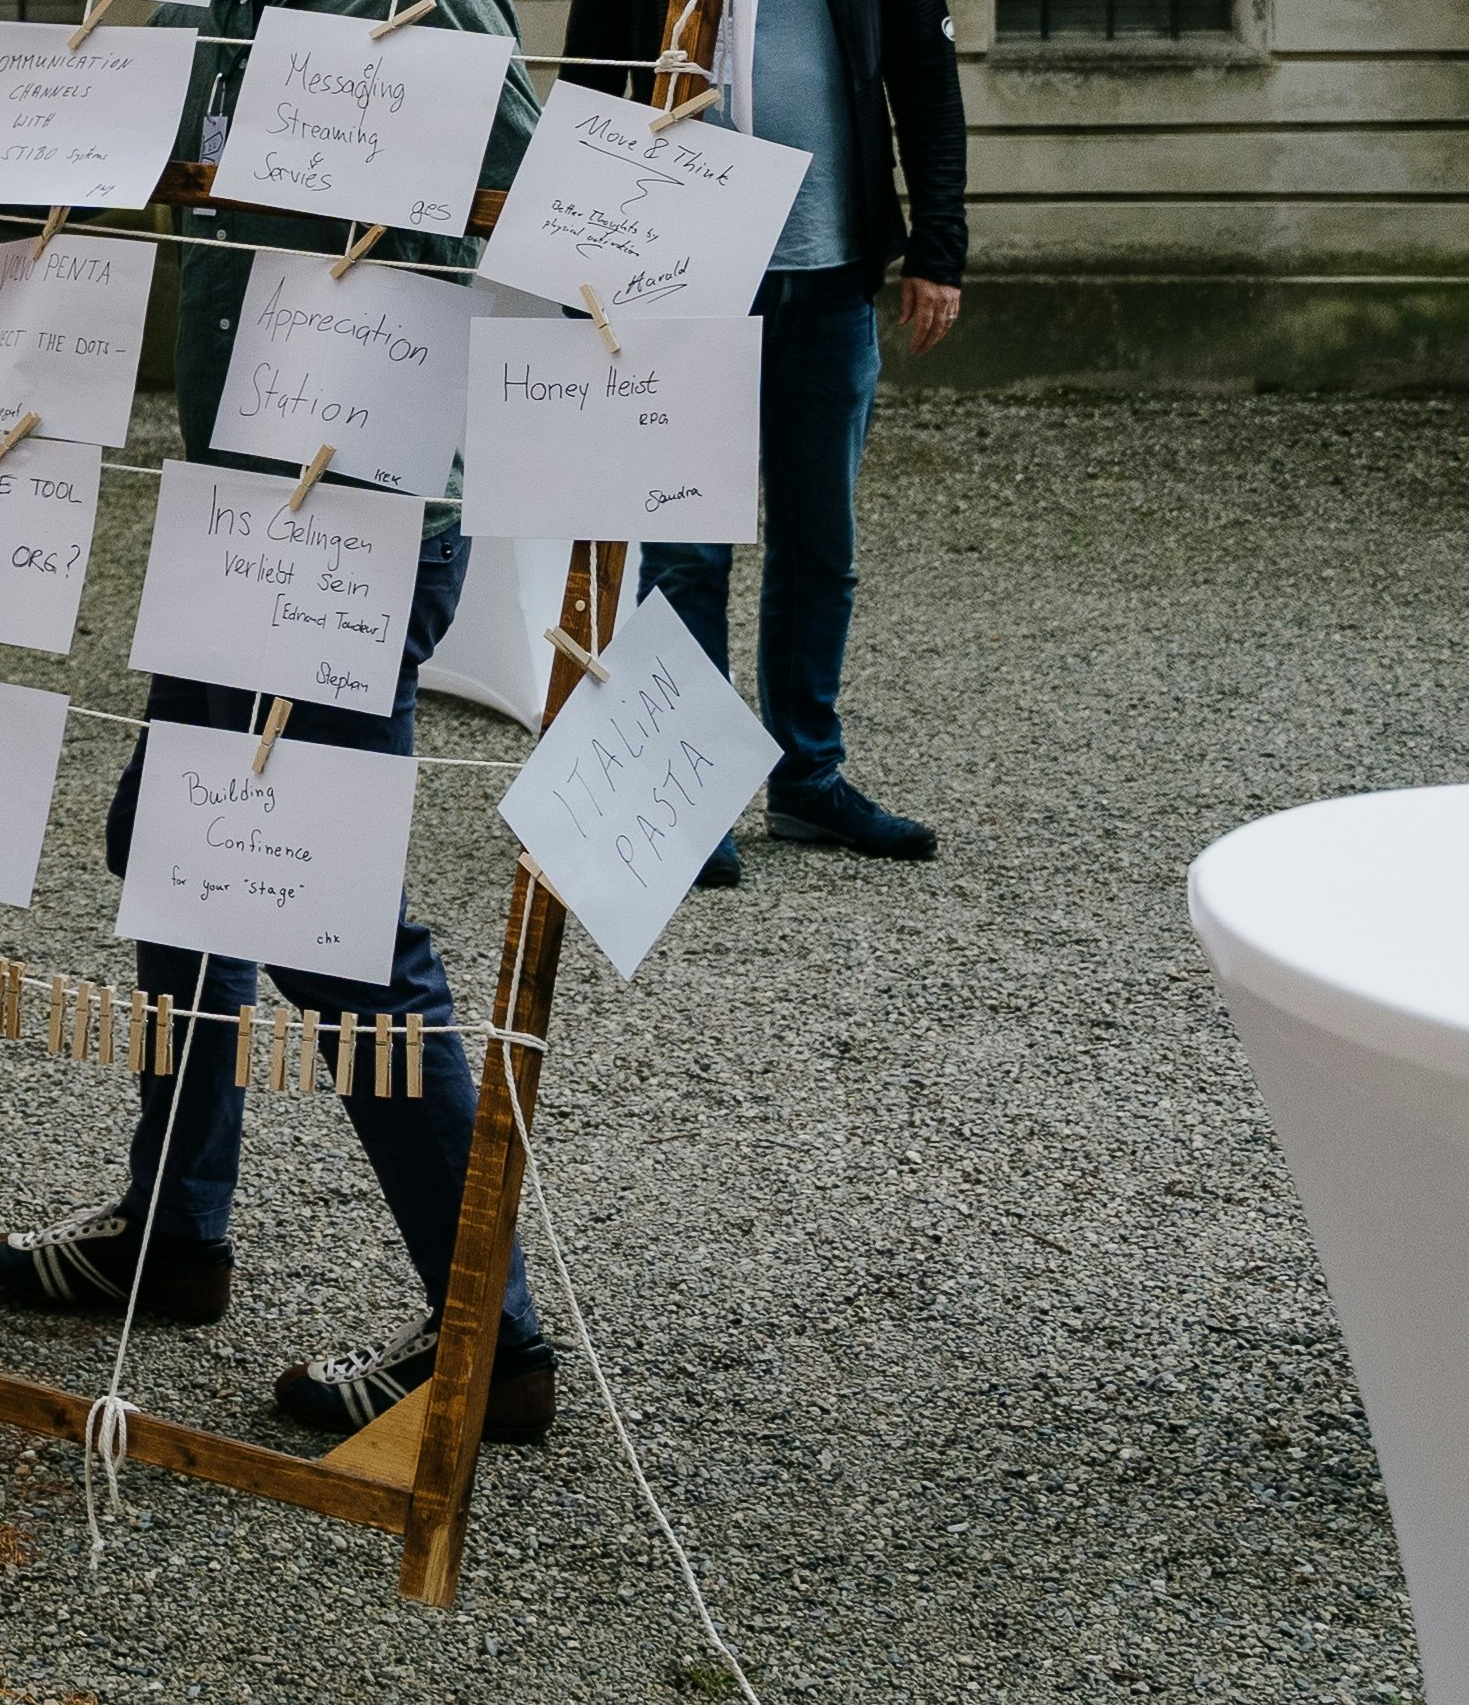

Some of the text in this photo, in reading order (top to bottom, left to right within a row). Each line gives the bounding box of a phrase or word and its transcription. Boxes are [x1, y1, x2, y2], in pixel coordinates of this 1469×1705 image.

[8, 84, 92, 101] CHANNELS
[574, 113, 638, 153] Move
[672, 144, 735, 186] Think
[42, 252, 112, 286] PENTA
[37, 332, 66, 353] THE
[258, 277, 429, 366] Appreciation
[239, 362, 370, 430] Station
[503, 362, 660, 411] Honey Heist
[30, 477, 83, 504] TOOL
[207, 484, 374, 572] Ins Gelingen
[317, 571, 370, 598] sein
[182, 770, 276, 813] Building
[614, 740, 715, 888] PASTA
[171, 864, 187, 887] for
[200, 878, 231, 902] your
